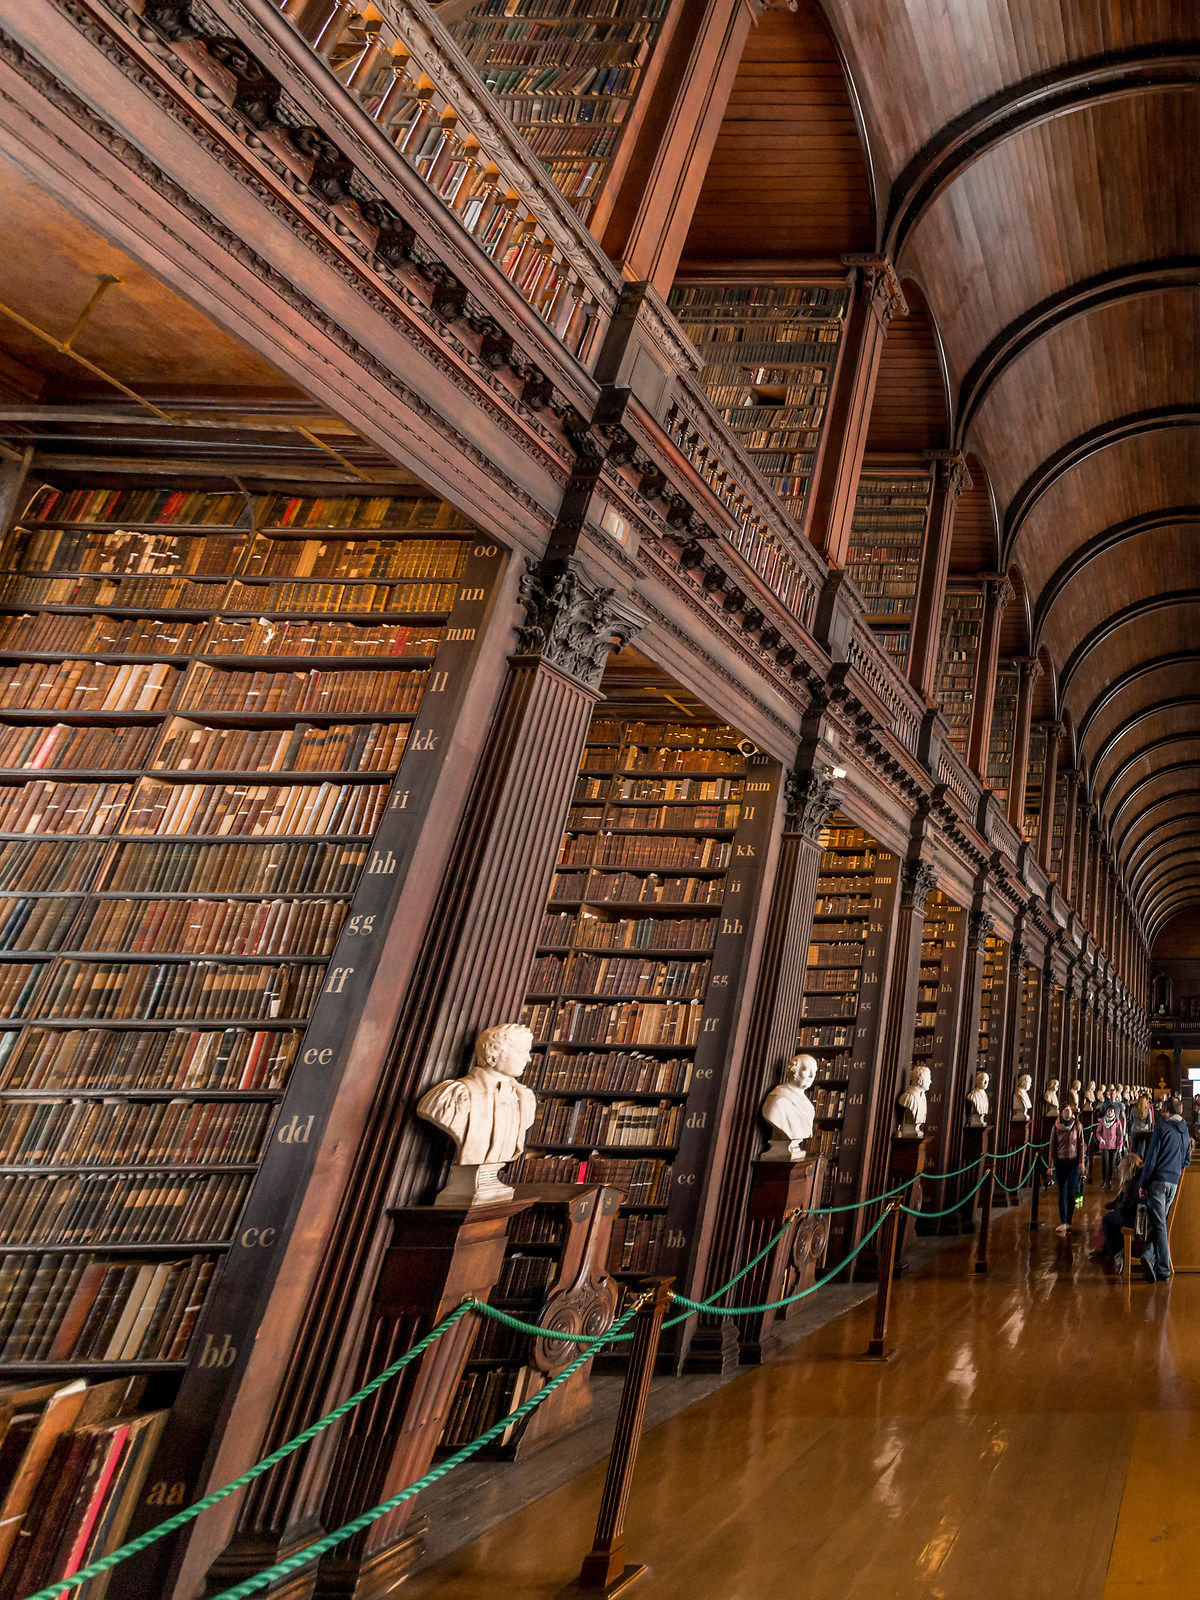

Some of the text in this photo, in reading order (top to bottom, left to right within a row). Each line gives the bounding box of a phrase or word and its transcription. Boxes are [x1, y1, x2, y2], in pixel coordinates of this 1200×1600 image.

[474, 545, 497, 558] oo
[460, 586, 484, 600] nn
[447, 627, 476, 640] mm
[430, 672, 449, 692] ll
[411, 730, 438, 750] kk
[746, 781, 770, 792] mm
[391, 791, 410, 809] ii
[743, 807, 755, 820] ll
[736, 844, 756, 856] kk
[879, 852, 891, 860] nn
[368, 851, 397, 874] hh
[875, 876, 891, 884] mm
[730, 881, 741, 893] ii
[874, 899, 881, 908] ll
[347, 912, 377, 935] gg
[722, 919, 743, 934] hh
[870, 923, 883, 932] kk
[868, 947, 875, 956] ii
[325, 968, 354, 994] ff
[712, 974, 729, 986] gg
[863, 973, 878, 983] hh
[861, 1002, 872, 1011] gg
[704, 1018, 719, 1032] ff
[858, 1027, 866, 1038] ff
[304, 1045, 333, 1065] ee
[853, 1060, 865, 1070] ee
[696, 1067, 713, 1079] ee
[849, 1094, 863, 1105] dd
[686, 1114, 707, 1129] dd
[278, 1116, 313, 1144] dd
[677, 1172, 695, 1185] cc
[839, 1172, 852, 1184] bb
[579, 1201, 589, 1214] T
[241, 1226, 275, 1248] cc
[667, 1230, 686, 1248] bb
[200, 1335, 236, 1369] bb
[146, 1482, 185, 1505] aa
